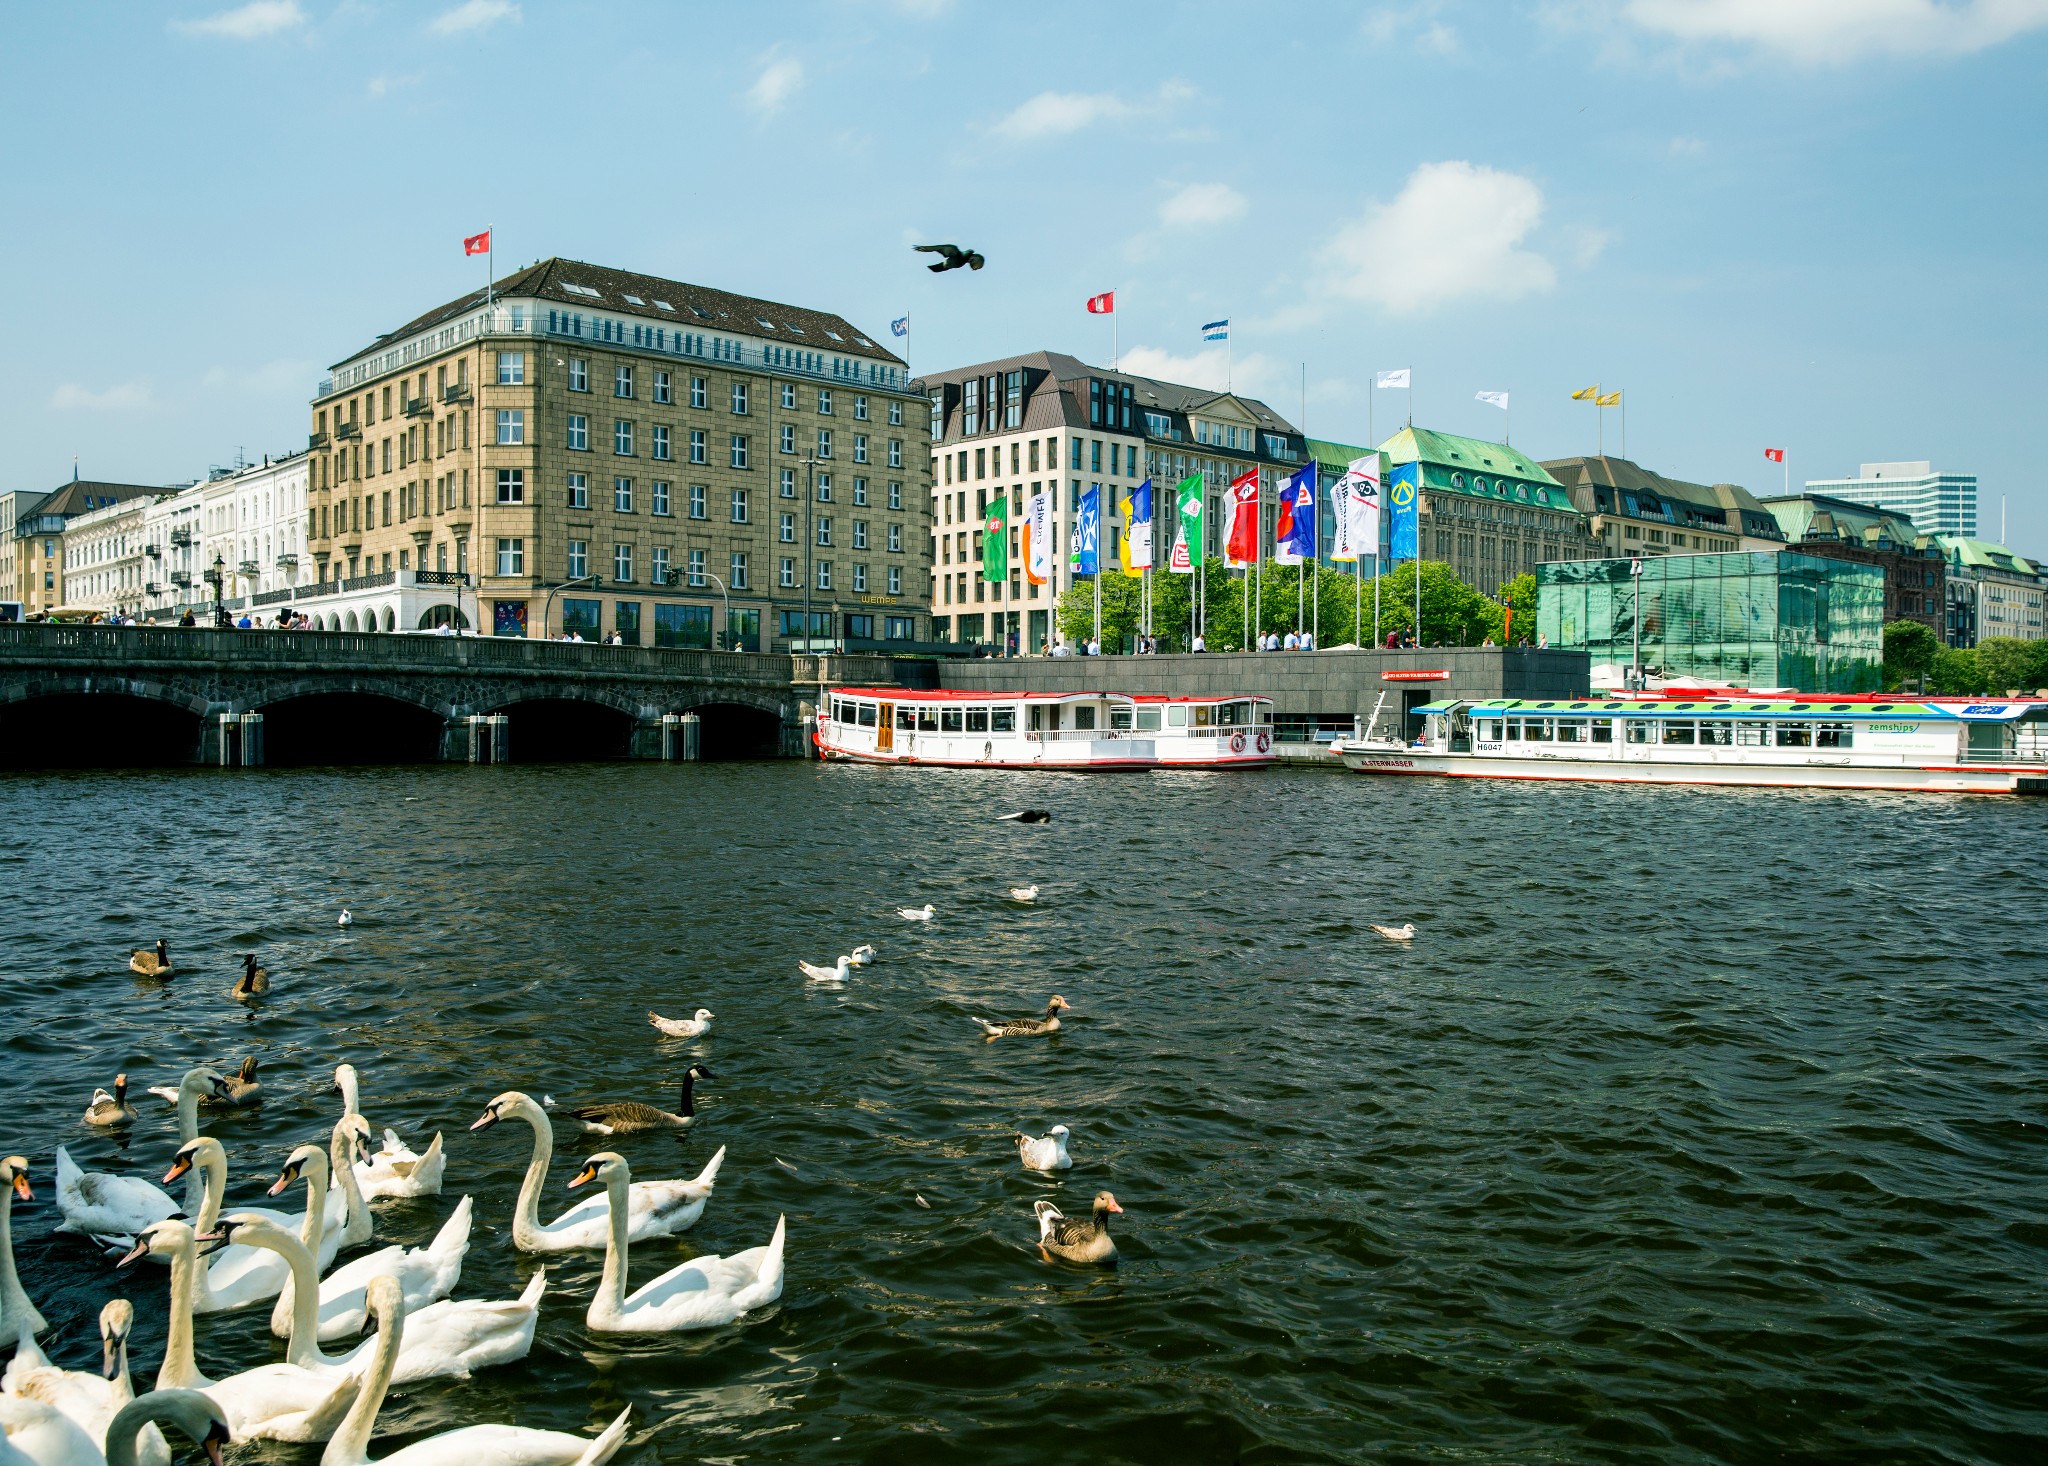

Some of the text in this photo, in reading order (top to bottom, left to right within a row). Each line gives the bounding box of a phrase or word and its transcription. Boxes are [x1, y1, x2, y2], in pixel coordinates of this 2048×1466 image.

[861, 595, 897, 605] WEMPE
[1869, 723, 1914, 732] zemships
[1477, 743, 1502, 751] H6047
